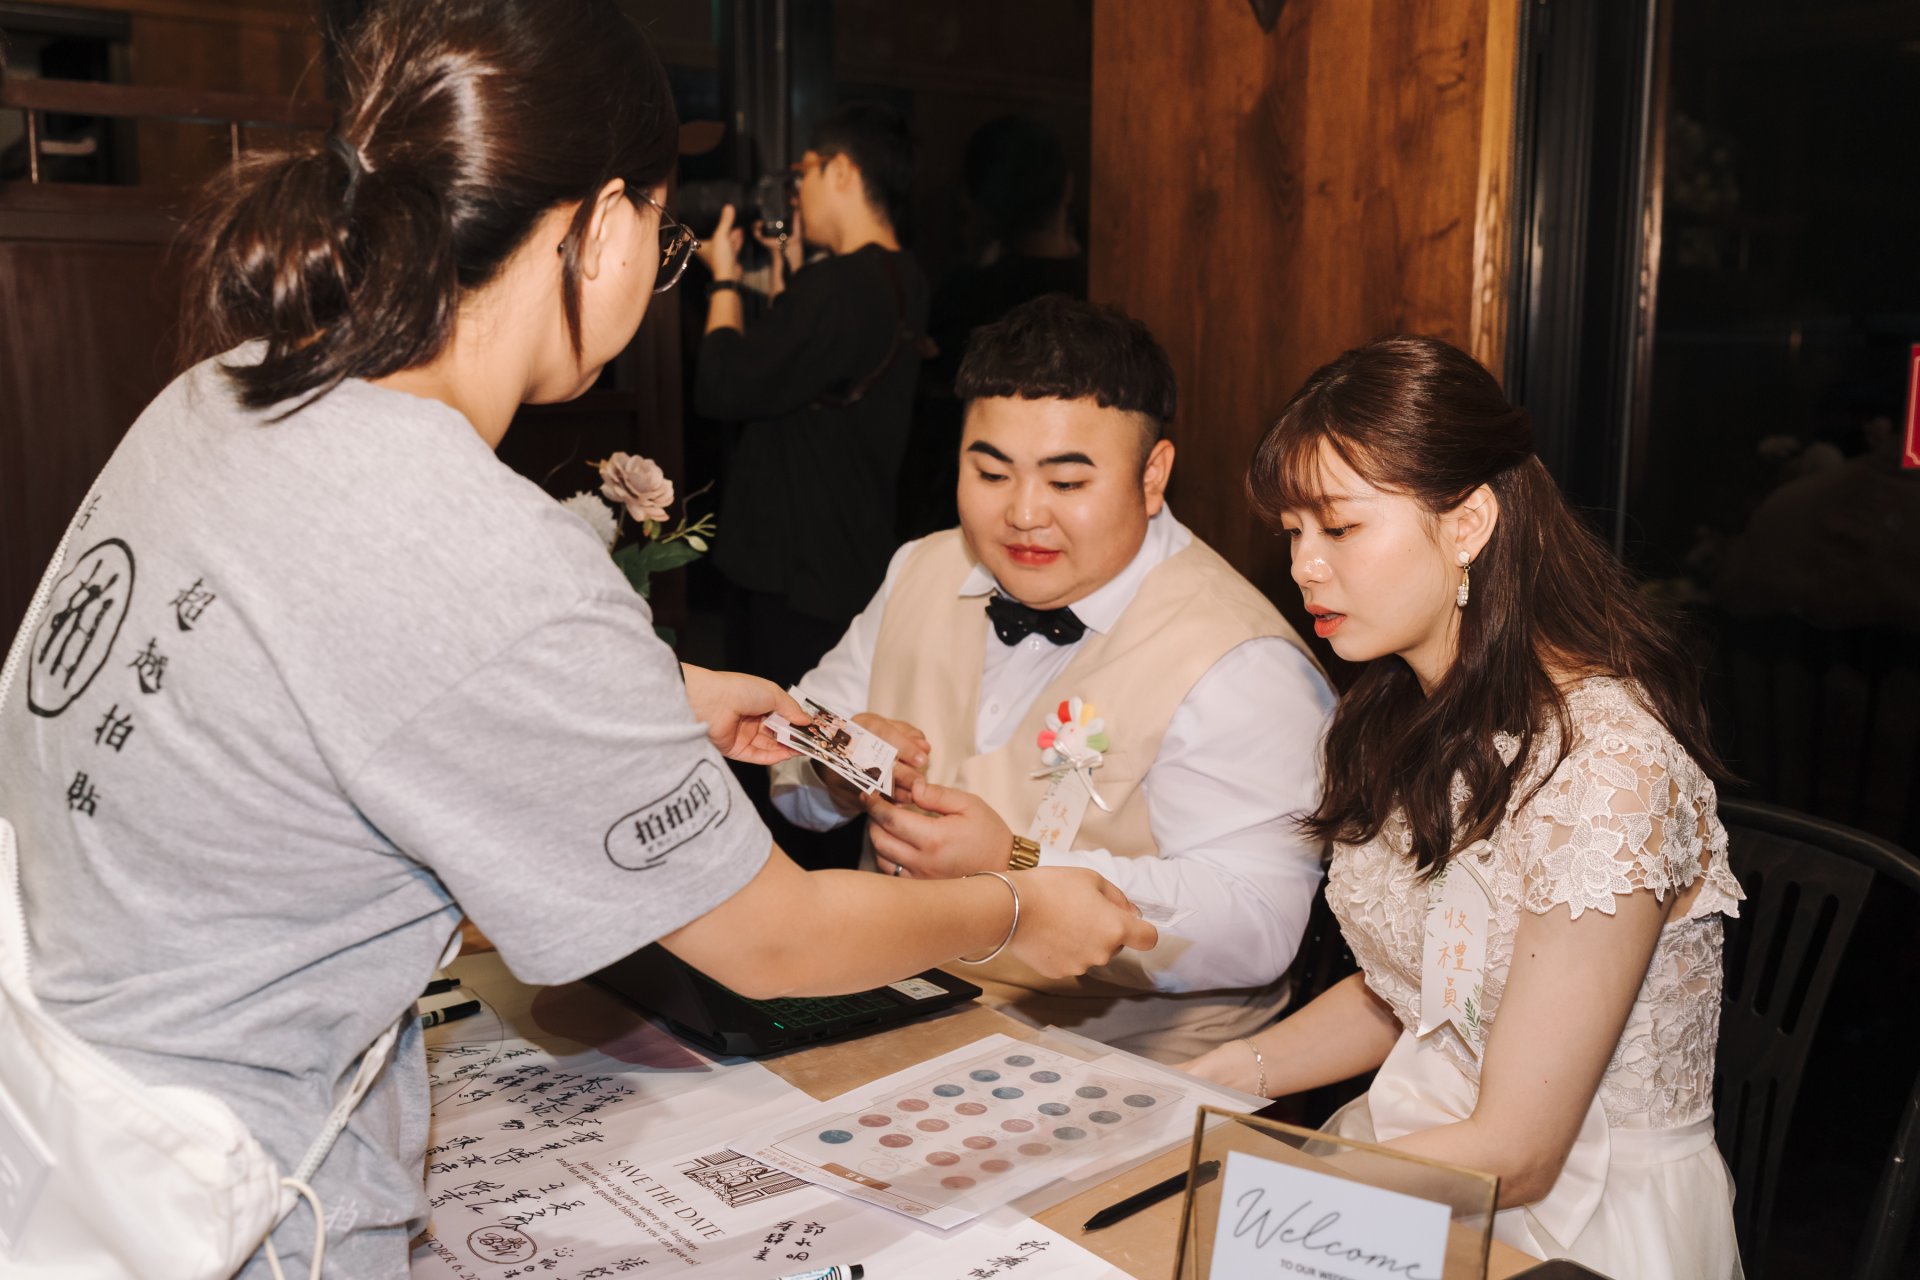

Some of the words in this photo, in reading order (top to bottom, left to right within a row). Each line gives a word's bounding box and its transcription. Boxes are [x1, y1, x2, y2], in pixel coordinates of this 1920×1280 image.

[1437, 907, 1474, 1013] 收禮員
[592, 1189, 623, 1208] greatest
[617, 1205, 649, 1229] blessings
[608, 1158, 654, 1187] SAVE
[645, 1183, 685, 1208] THE
[674, 1206, 726, 1240] DATE
[638, 1204, 661, 1221] where
[1233, 1187, 1443, 1280] Welcome
[1280, 1258, 1294, 1272] TO
[1295, 1263, 1316, 1276] OUR
